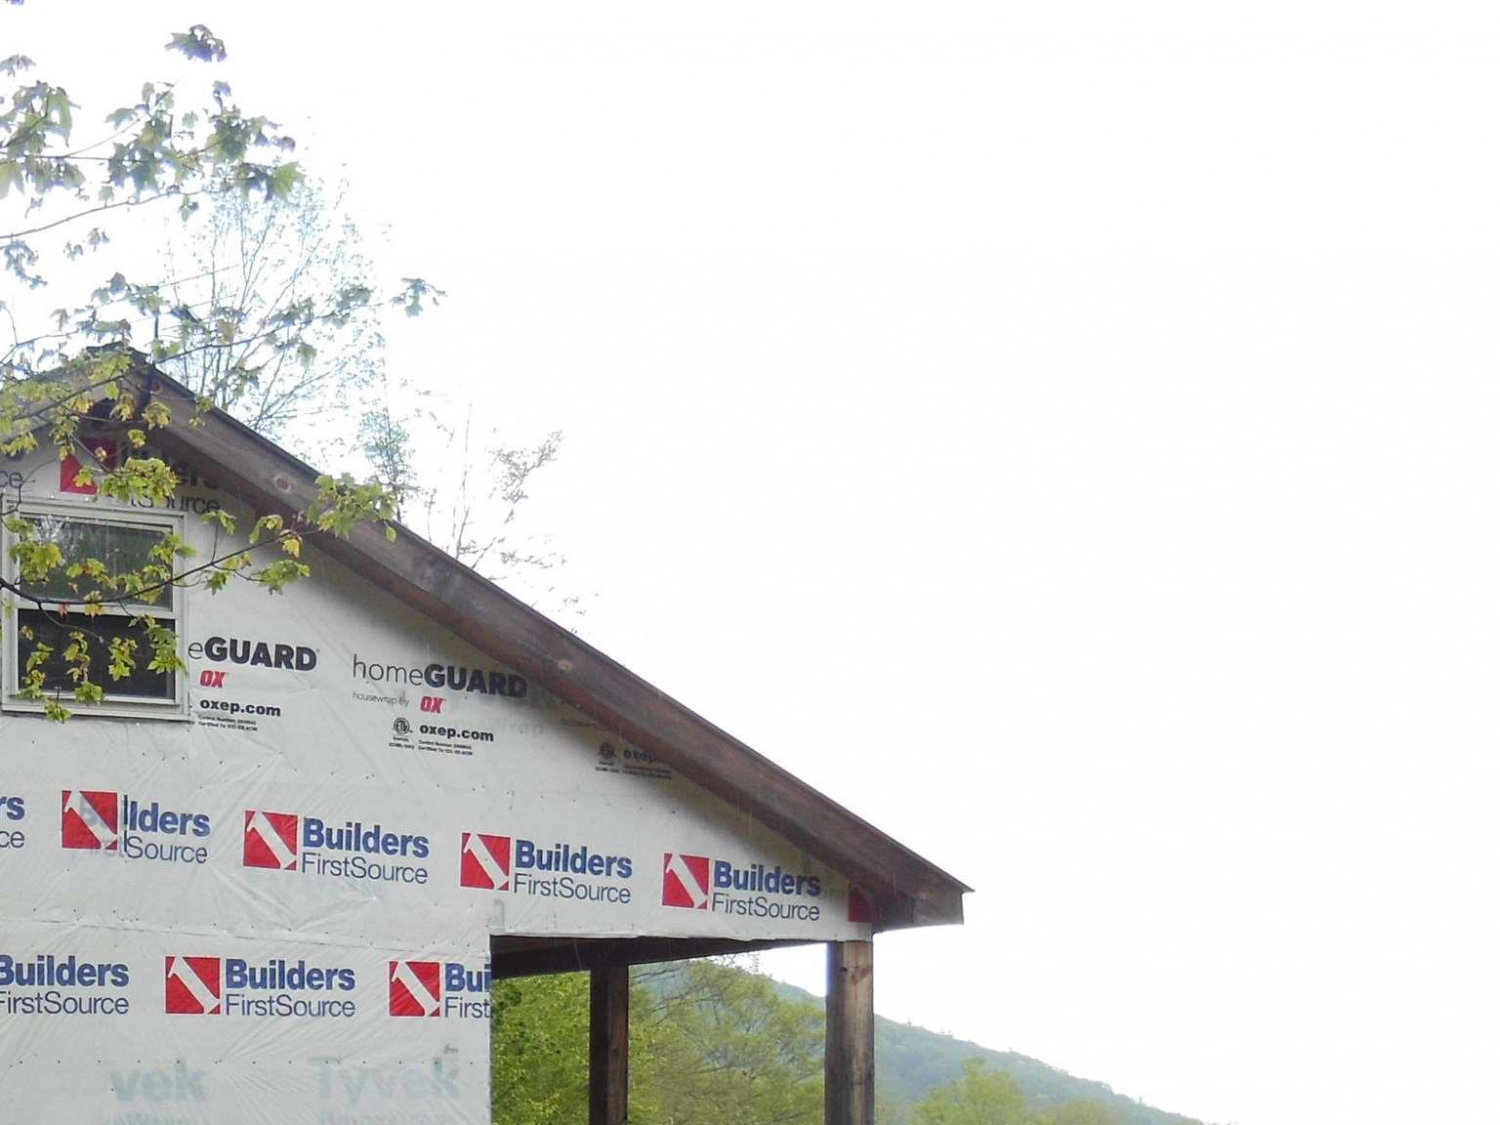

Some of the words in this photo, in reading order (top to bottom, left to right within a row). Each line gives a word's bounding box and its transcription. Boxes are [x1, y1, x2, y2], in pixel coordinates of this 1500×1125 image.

[188, 636, 317, 671] eGUARD
[199, 670, 226, 688] OX
[352, 653, 528, 698] homeGUARD
[200, 699, 281, 717] oxep.com
[420, 695, 444, 714] OX
[419, 724, 494, 742] oxep.com
[302, 817, 429, 859] Builders
[301, 852, 428, 885] FirstSource
[515, 840, 633, 879] Builders
[513, 873, 631, 904] FirstSource
[714, 860, 821, 897] Builders
[712, 892, 820, 921] FirstSource
[225, 958, 355, 992] Builders
[225, 994, 355, 1018] FirstSource
